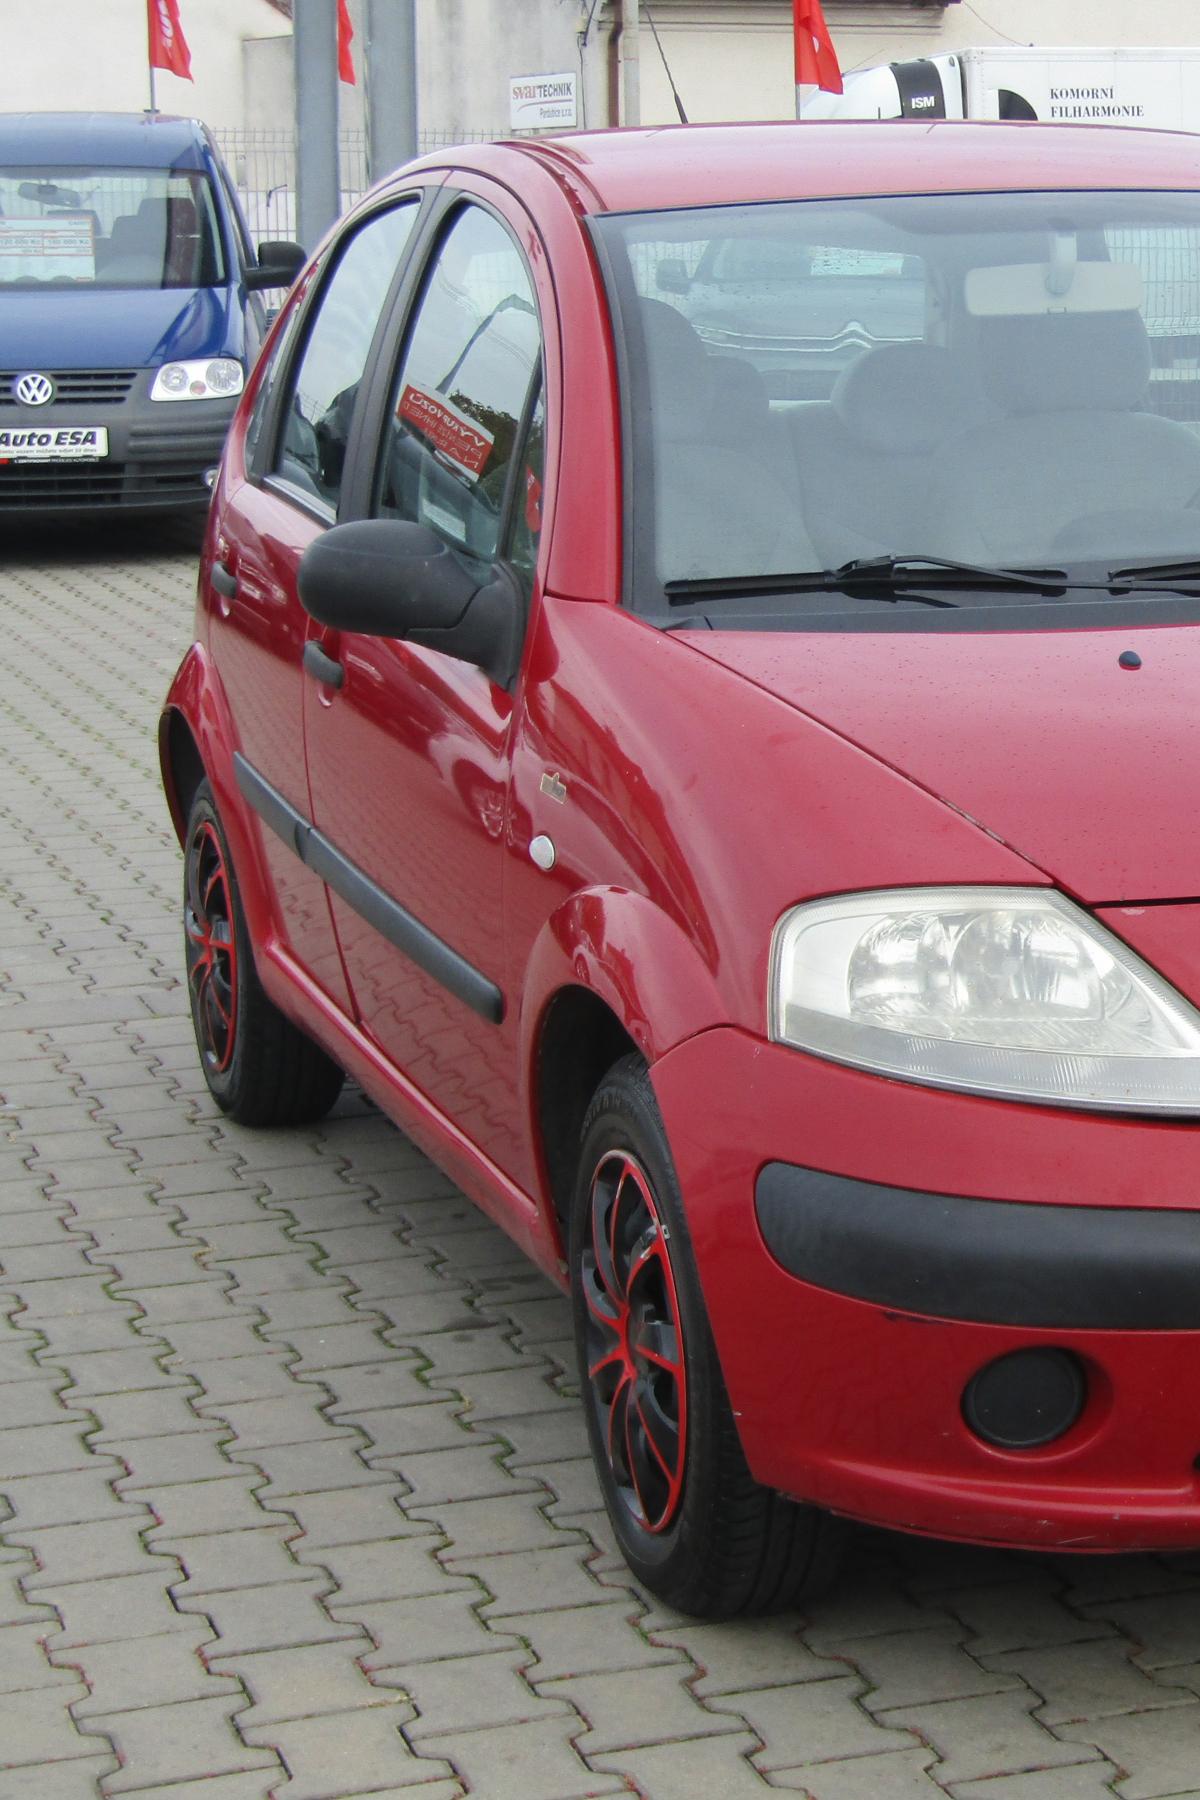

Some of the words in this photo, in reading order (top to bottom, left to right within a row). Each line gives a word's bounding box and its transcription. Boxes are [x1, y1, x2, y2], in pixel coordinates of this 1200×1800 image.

[1050, 85, 1115, 100] KOMORNÍ
[911, 95, 935, 109] ISM
[1050, 105, 1145, 119] FILHARMONIE
[0, 432, 52, 446] Auto
[55, 431, 97, 446] ESA
